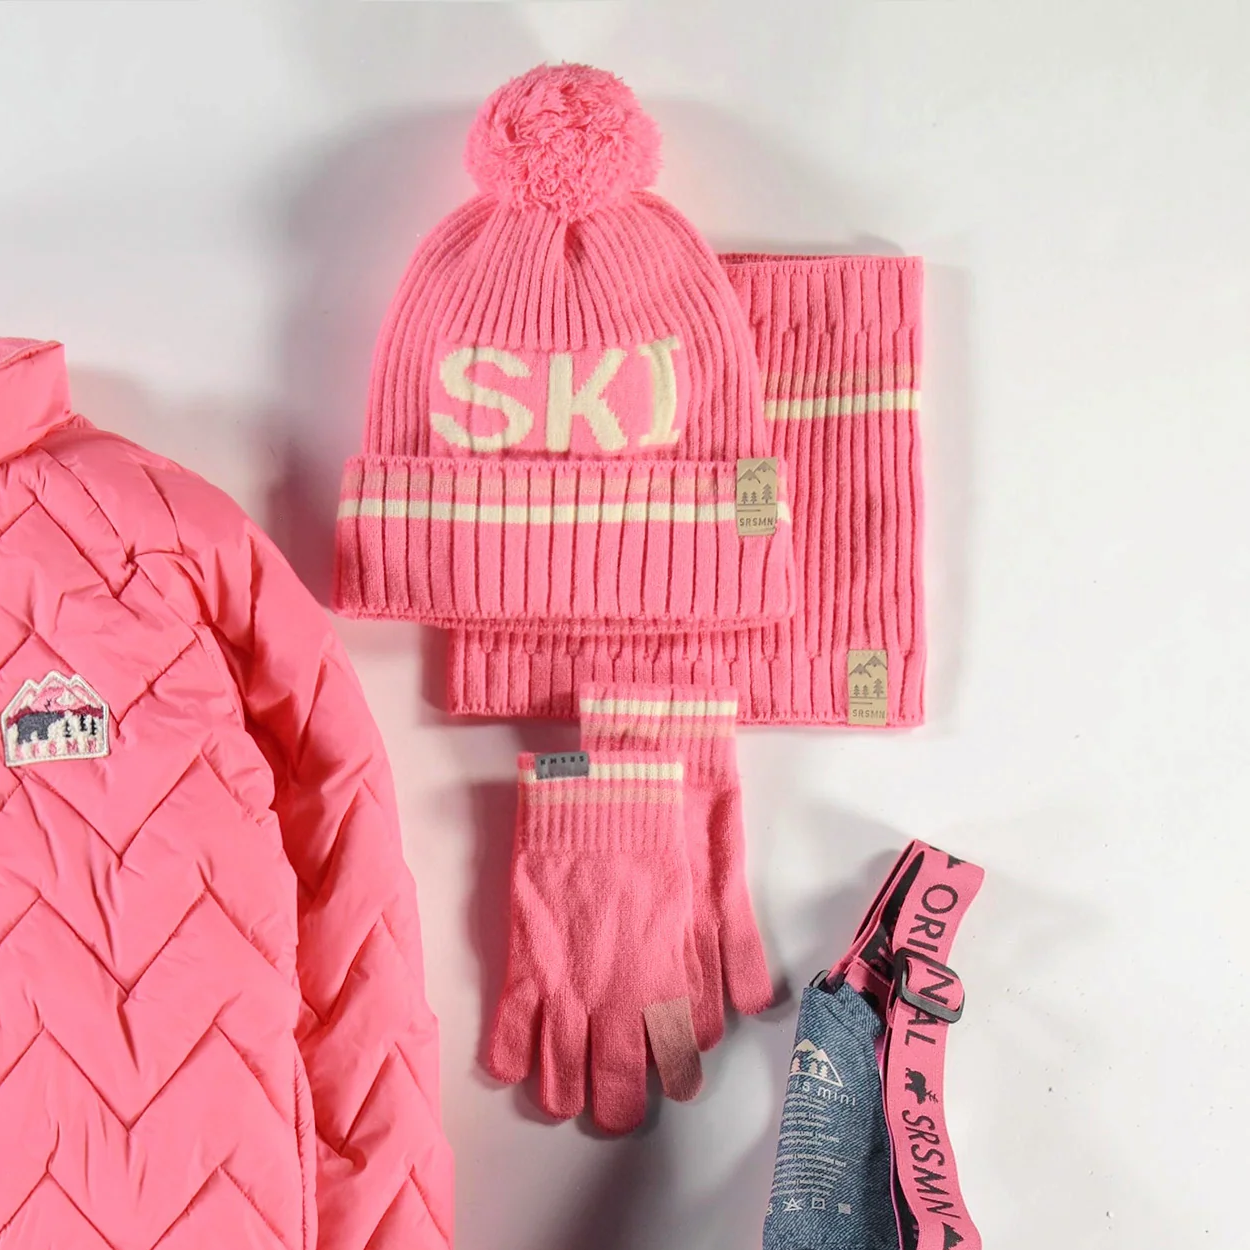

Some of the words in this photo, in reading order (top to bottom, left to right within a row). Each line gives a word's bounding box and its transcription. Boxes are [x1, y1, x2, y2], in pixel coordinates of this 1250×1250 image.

[429, 335, 681, 452] SKI
[739, 517, 775, 527] SRSMN
[852, 708, 886, 719] SRSMN
[817, 1086, 857, 1106] mini
[902, 1109, 961, 1225] SRSMN
